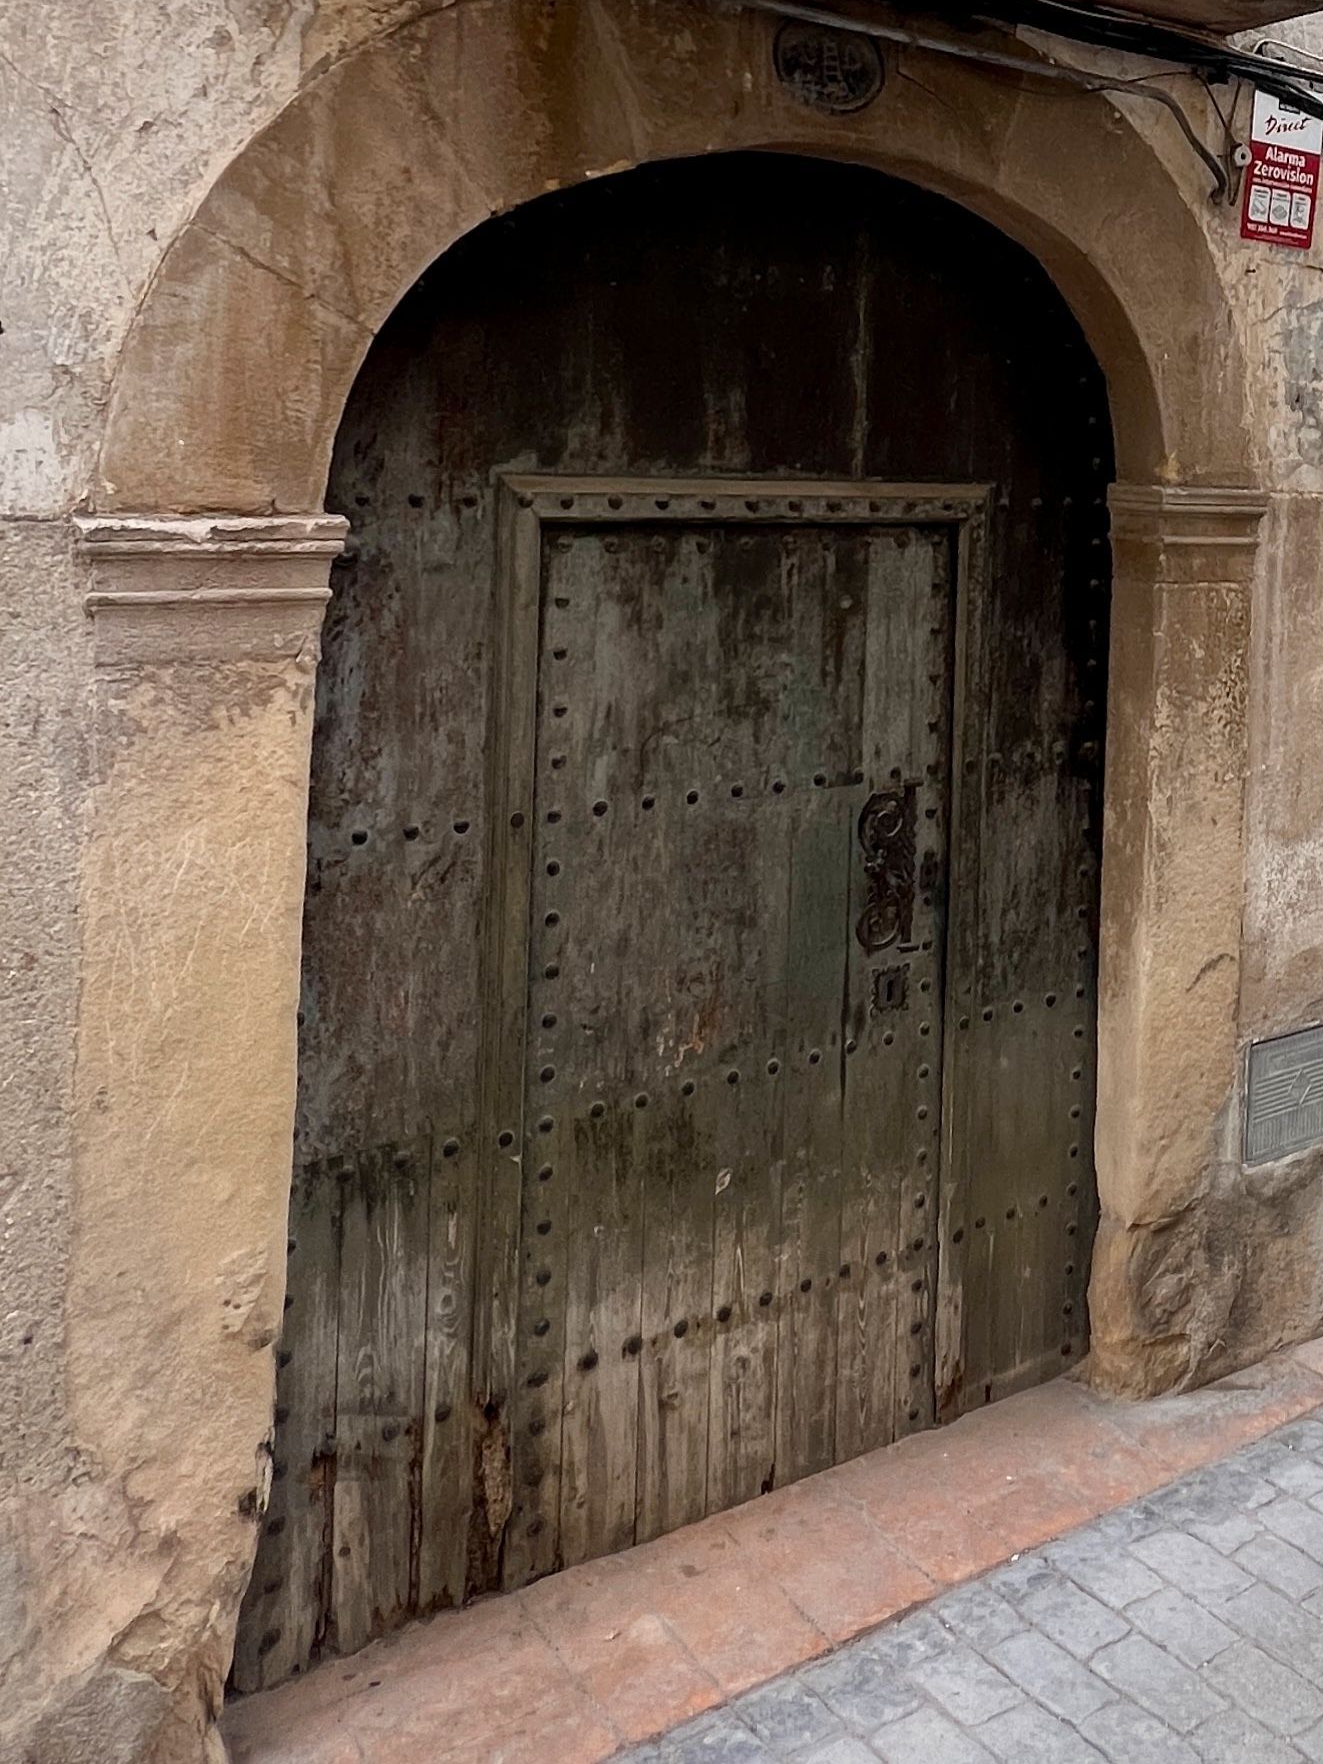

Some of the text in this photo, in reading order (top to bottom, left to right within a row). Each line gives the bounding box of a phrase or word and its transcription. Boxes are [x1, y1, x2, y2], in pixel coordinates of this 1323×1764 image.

[1265, 115, 1312, 135] Direct
[1265, 146, 1306, 167] Alarma
[1253, 160, 1314, 185] Zerovision
